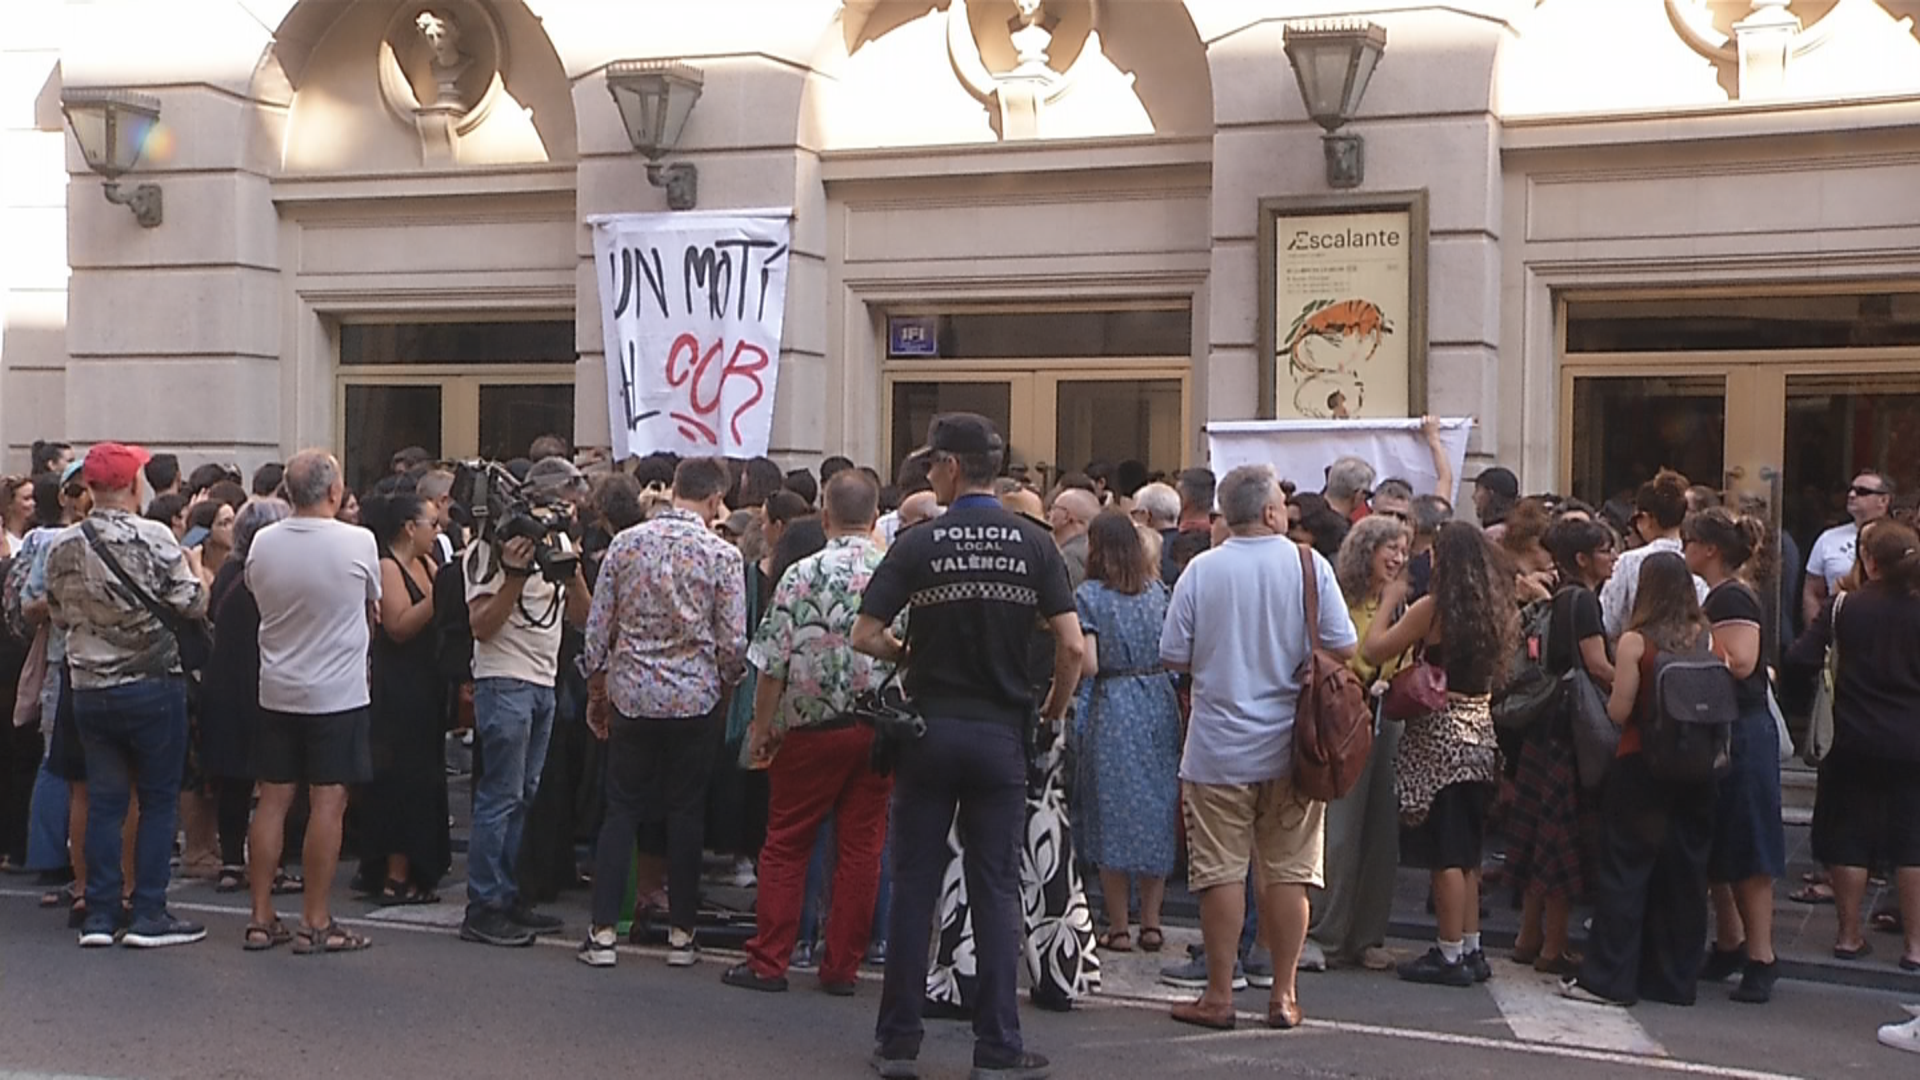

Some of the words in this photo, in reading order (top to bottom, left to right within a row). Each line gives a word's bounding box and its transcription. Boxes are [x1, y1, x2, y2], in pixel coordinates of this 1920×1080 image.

[610, 247, 669, 320] UN
[665, 333, 769, 446] COR
[933, 527, 1022, 542] POLICIA
[956, 541, 1003, 551] LOCAL
